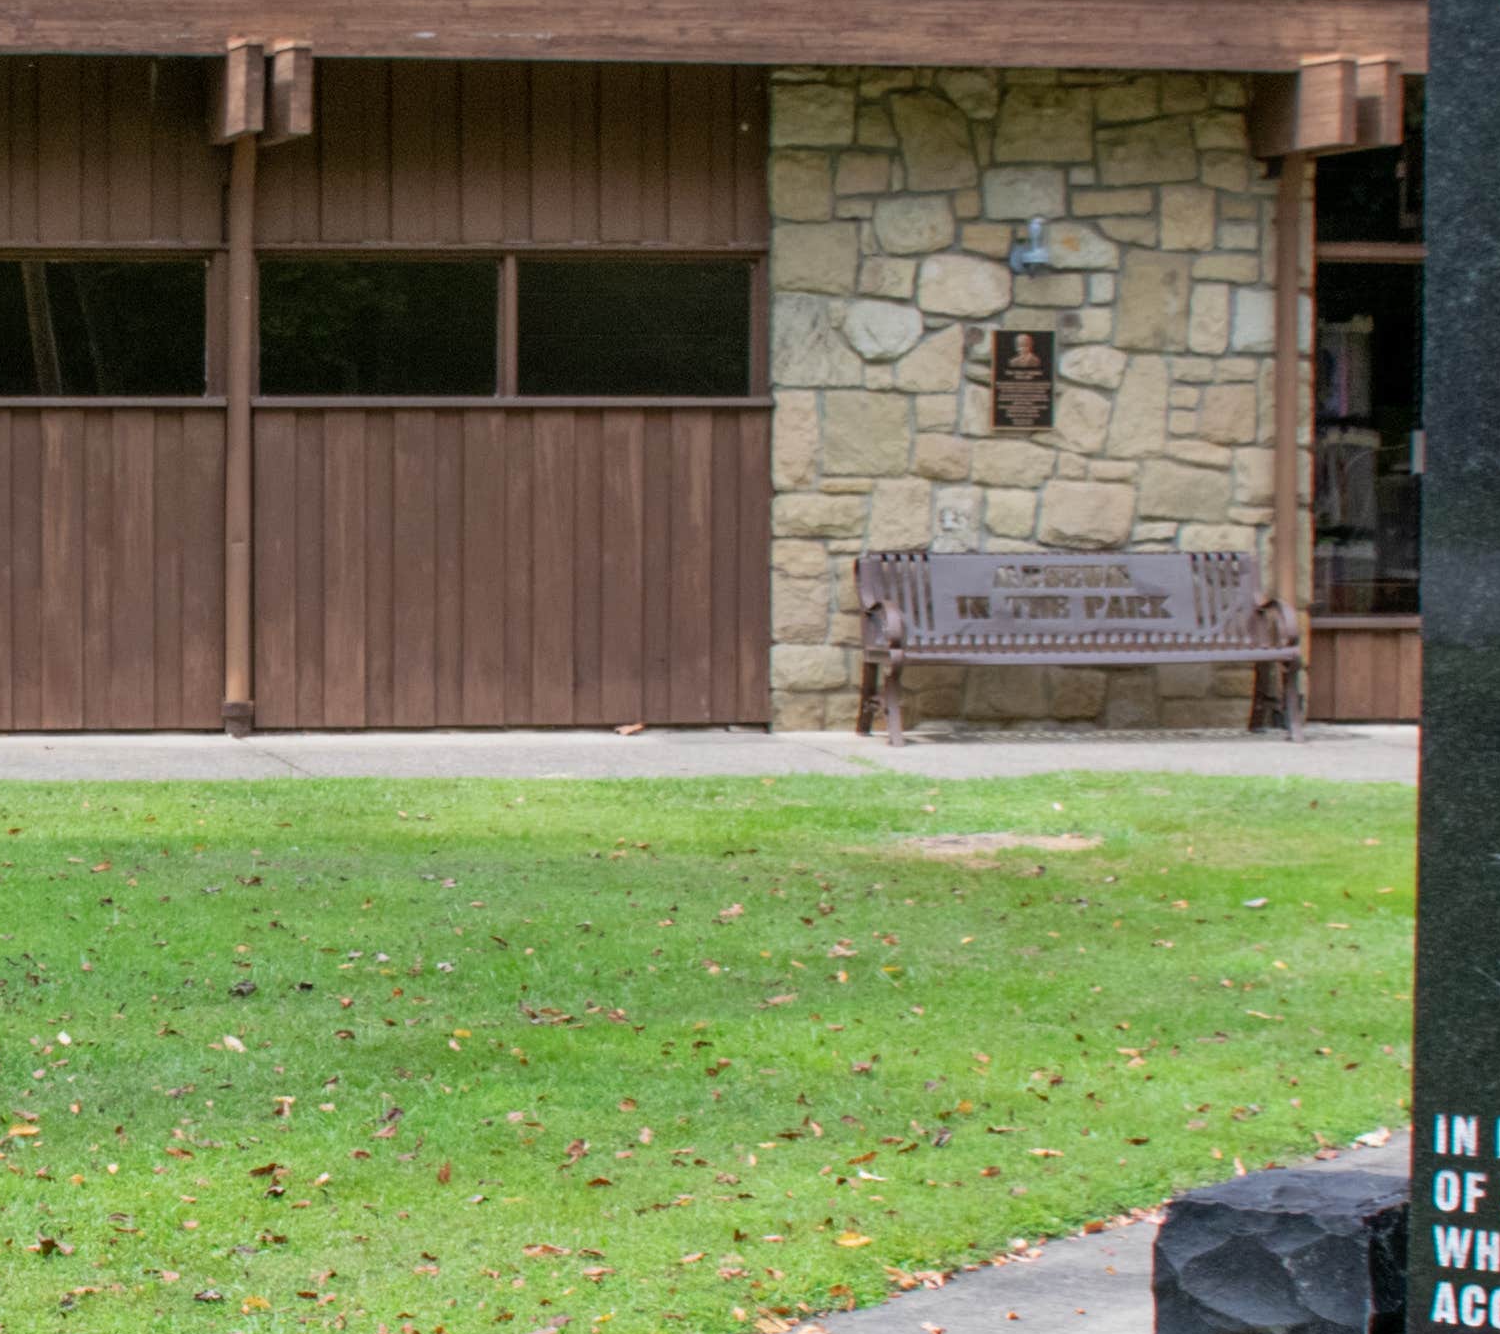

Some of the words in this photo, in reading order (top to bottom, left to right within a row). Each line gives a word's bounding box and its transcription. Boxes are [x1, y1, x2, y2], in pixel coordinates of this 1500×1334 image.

[955, 595, 990, 619] IN
[1004, 595, 1070, 619] THE
[1083, 595, 1175, 619] PARK
[1436, 1115, 1477, 1156] IN
[1435, 1170, 1486, 1213] OF
